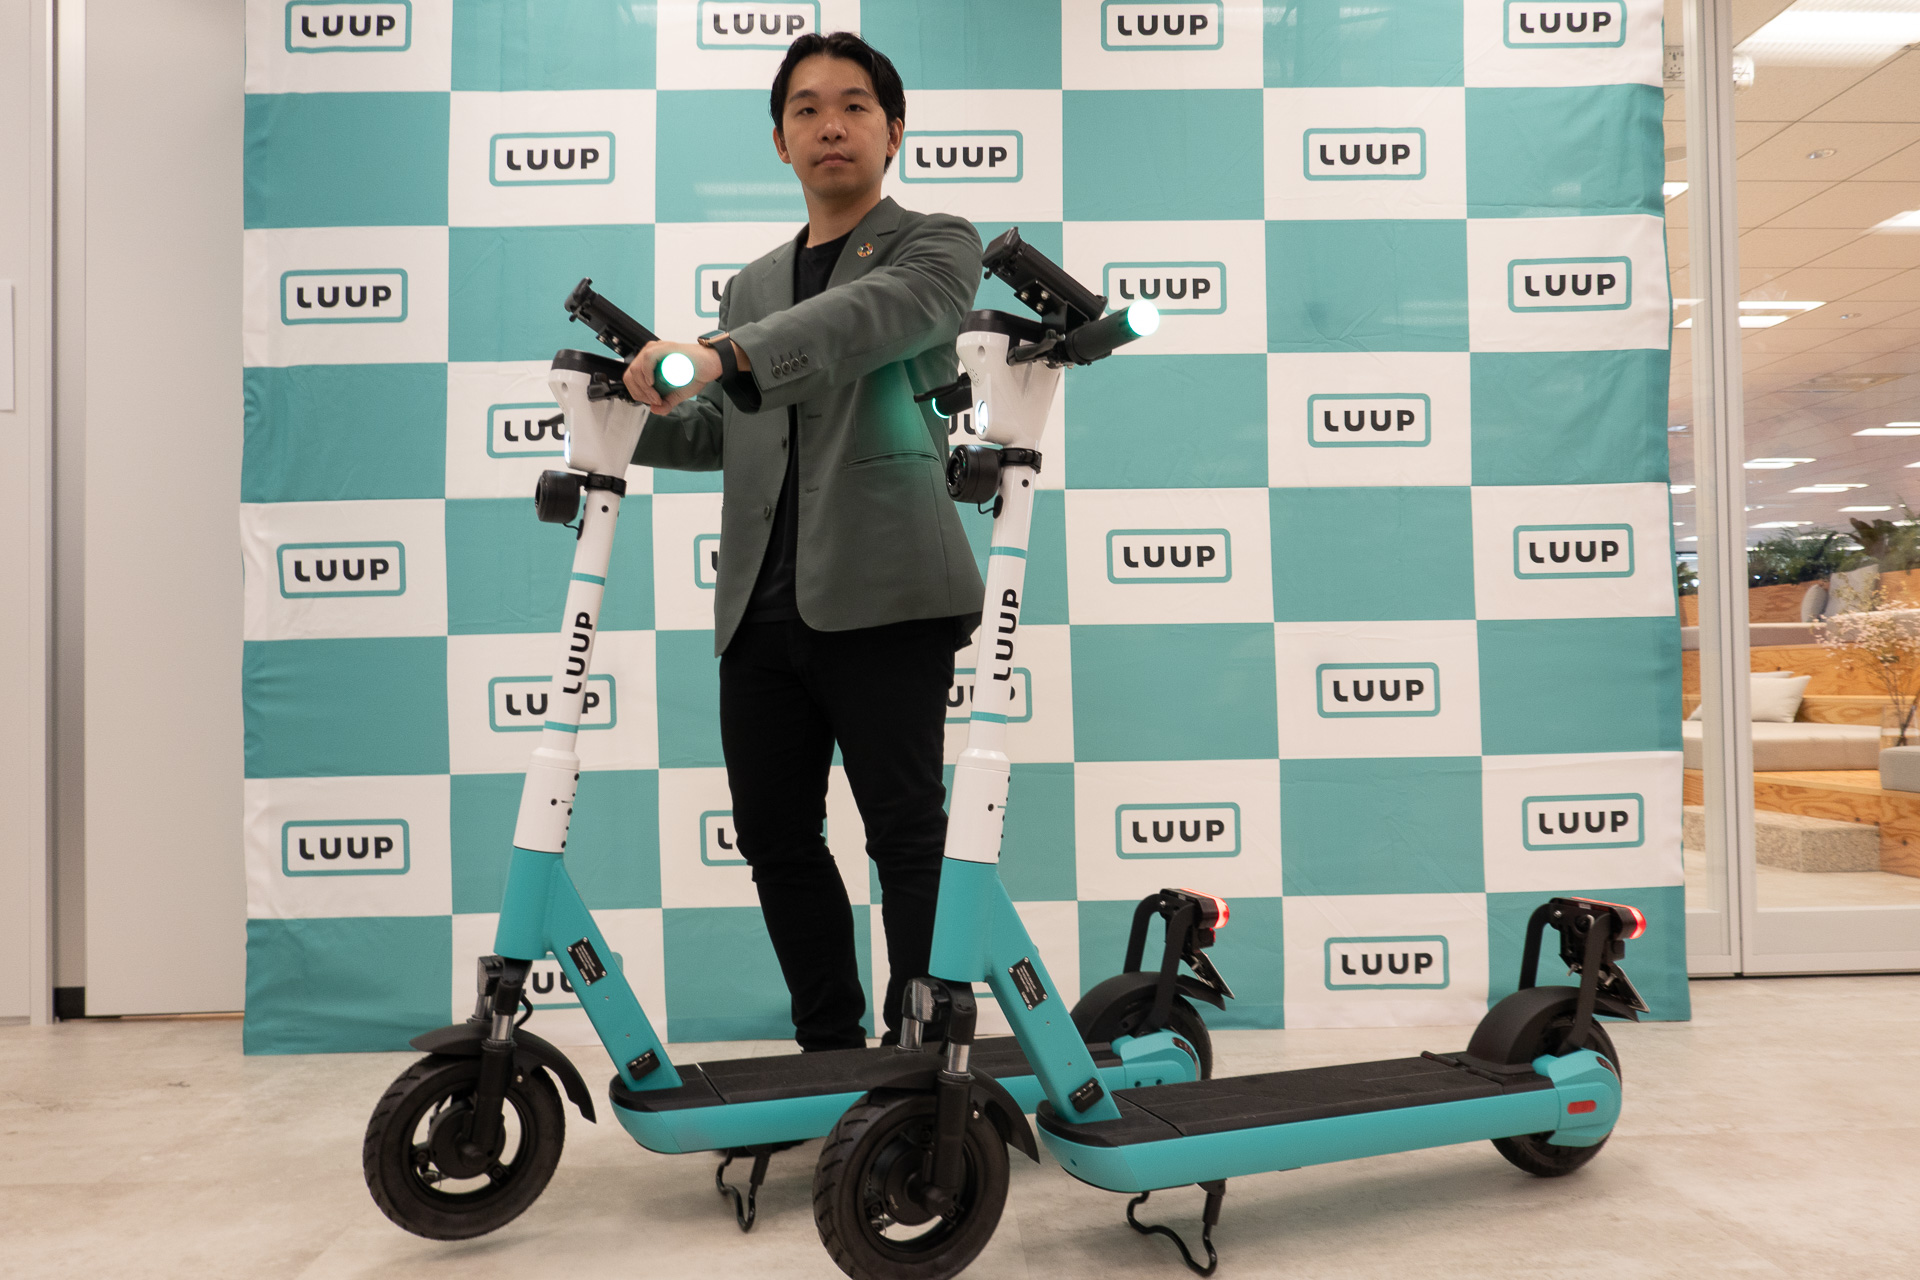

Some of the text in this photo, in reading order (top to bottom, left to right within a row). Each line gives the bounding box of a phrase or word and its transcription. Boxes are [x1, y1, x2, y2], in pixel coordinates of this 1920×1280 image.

[301, 15, 396, 38] LUUP
[712, 13, 806, 36] LUUP
[1117, 14, 1208, 36] LUUP
[1520, 11, 1611, 34] LUUP
[506, 148, 599, 171] LUUP
[916, 146, 1008, 168] LUUP
[1320, 144, 1410, 166] LUUP
[1119, 278, 1211, 300] LUUP
[1524, 273, 1616, 297] LUUP
[296, 285, 392, 309] LUUP
[1324, 409, 1415, 432] LUUP
[1123, 545, 1215, 568] LUUP
[1529, 540, 1619, 564] LUUP
[294, 558, 389, 582] LUUP
[992, 588, 1020, 682] LUUP
[562, 611, 594, 695] LUUP
[1333, 679, 1424, 702] LUUP
[505, 692, 600, 716] LUP
[1132, 819, 1225, 843] LUUP
[1538, 810, 1629, 835] LUUP
[299, 836, 394, 861] LUUP
[1341, 952, 1433, 976] LUUP
